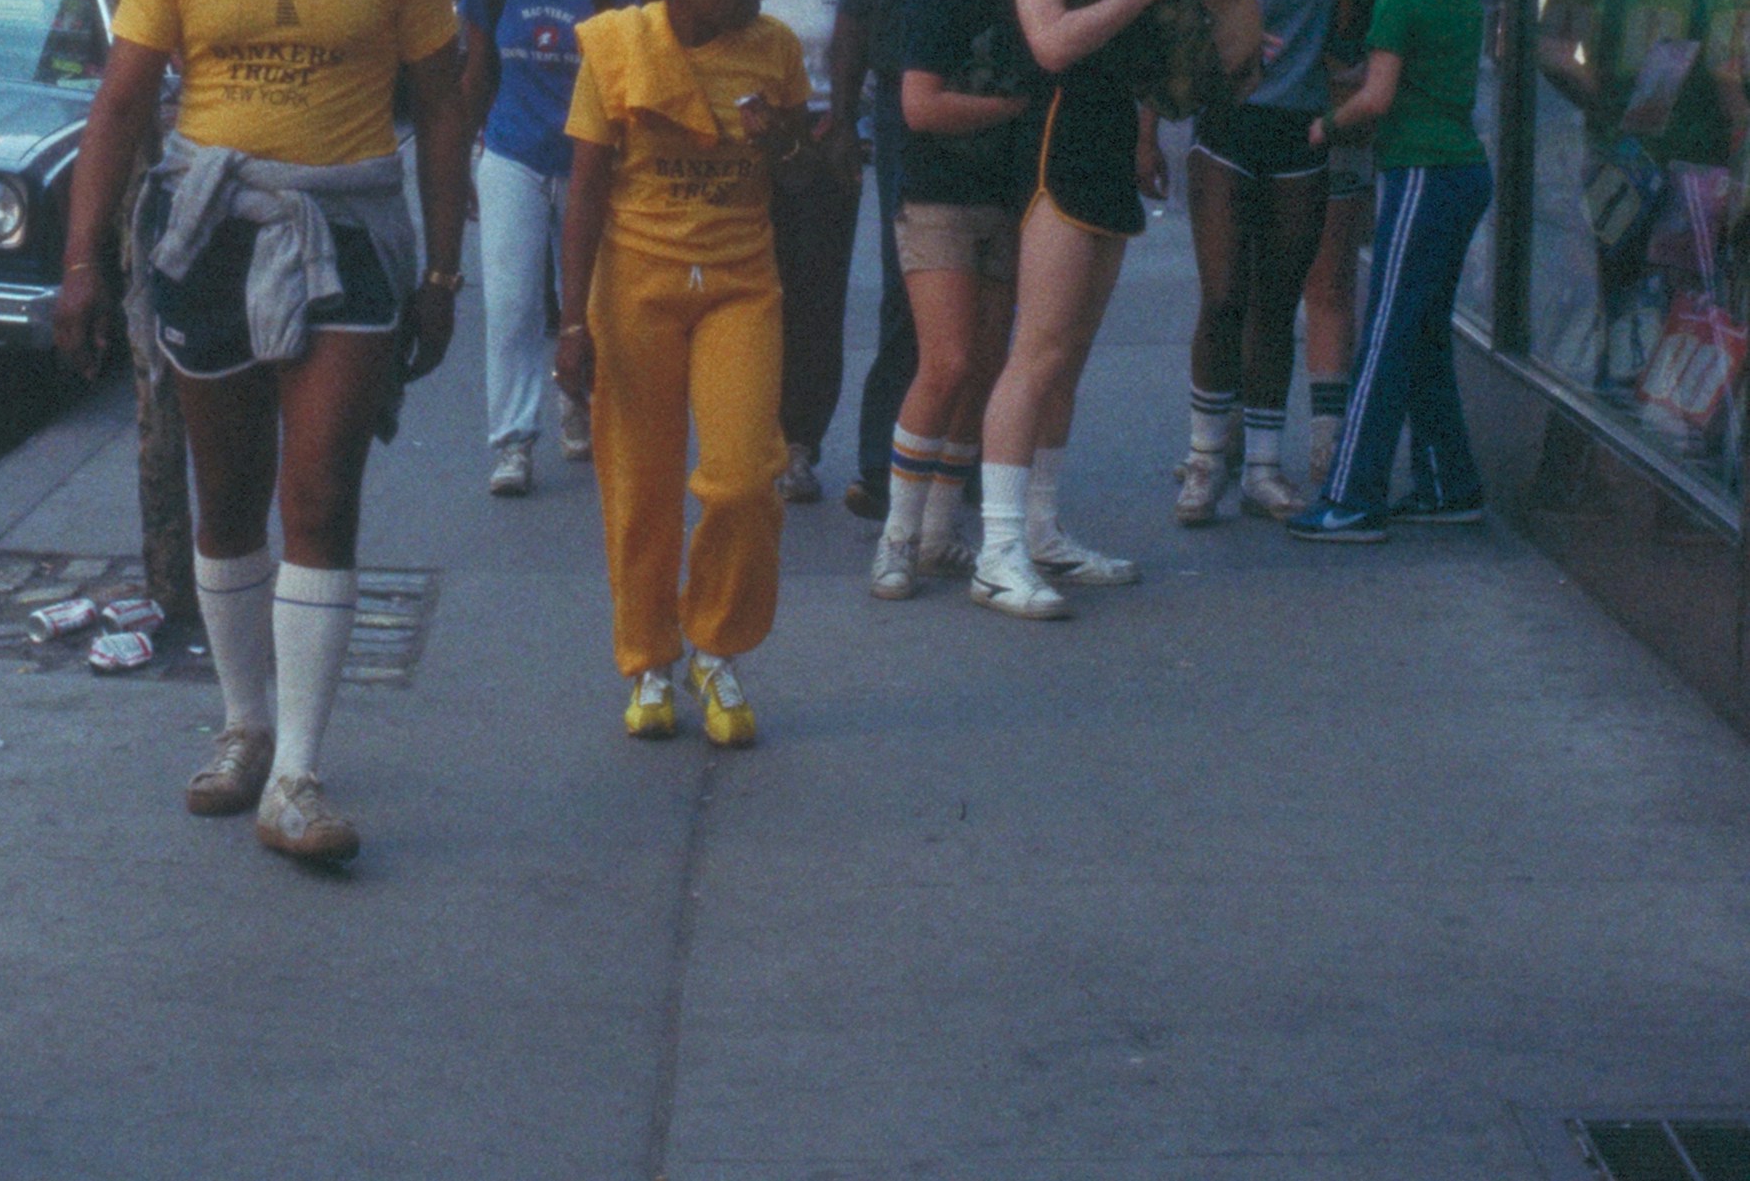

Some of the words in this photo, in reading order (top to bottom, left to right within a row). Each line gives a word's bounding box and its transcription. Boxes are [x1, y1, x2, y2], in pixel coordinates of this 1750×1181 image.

[210, 41, 344, 67] BANKERS
[228, 63, 316, 86] TRUST
[222, 85, 256, 102] NEW
[260, 87, 310, 108] YORK
